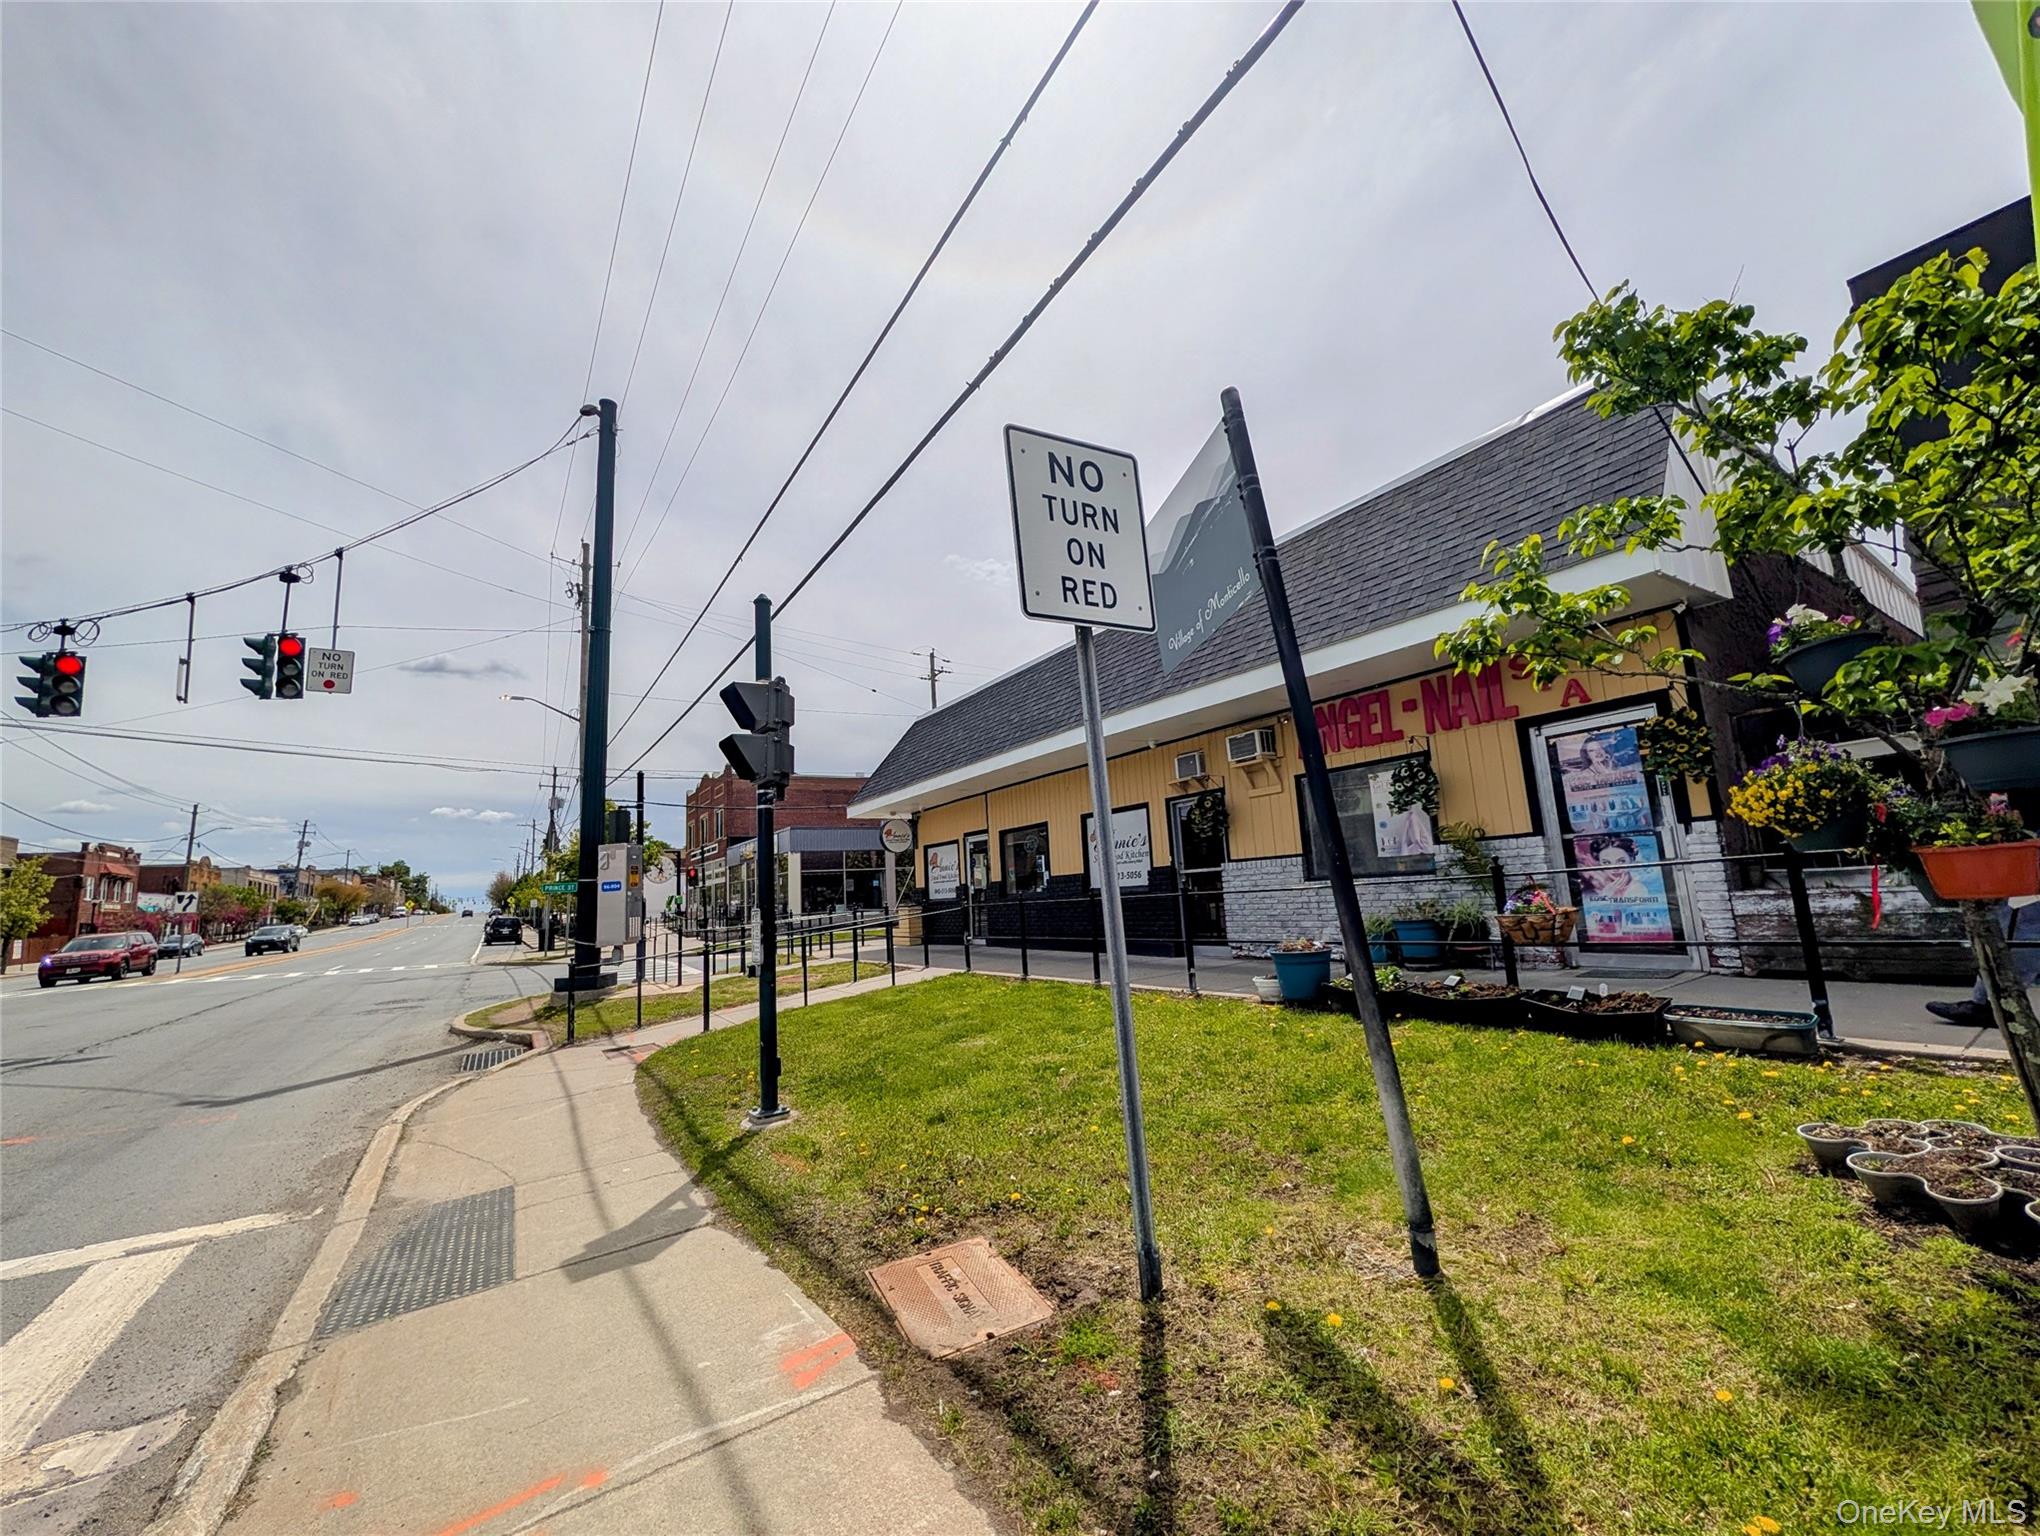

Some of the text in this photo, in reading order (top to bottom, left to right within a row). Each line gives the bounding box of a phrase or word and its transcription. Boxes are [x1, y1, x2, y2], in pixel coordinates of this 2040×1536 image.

[1047, 451, 1104, 493] NO
[1041, 493, 1120, 534] TURN
[1066, 537, 1106, 570] ON
[1061, 575, 1117, 609] RED
[1168, 566, 1250, 650] Village of Monticello
[319, 662, 344, 670] TURN
[322, 652, 341, 661] NO
[567, 883, 575, 891] ST
[929, 1260, 983, 1320] TRAFFIC SIGNAL
